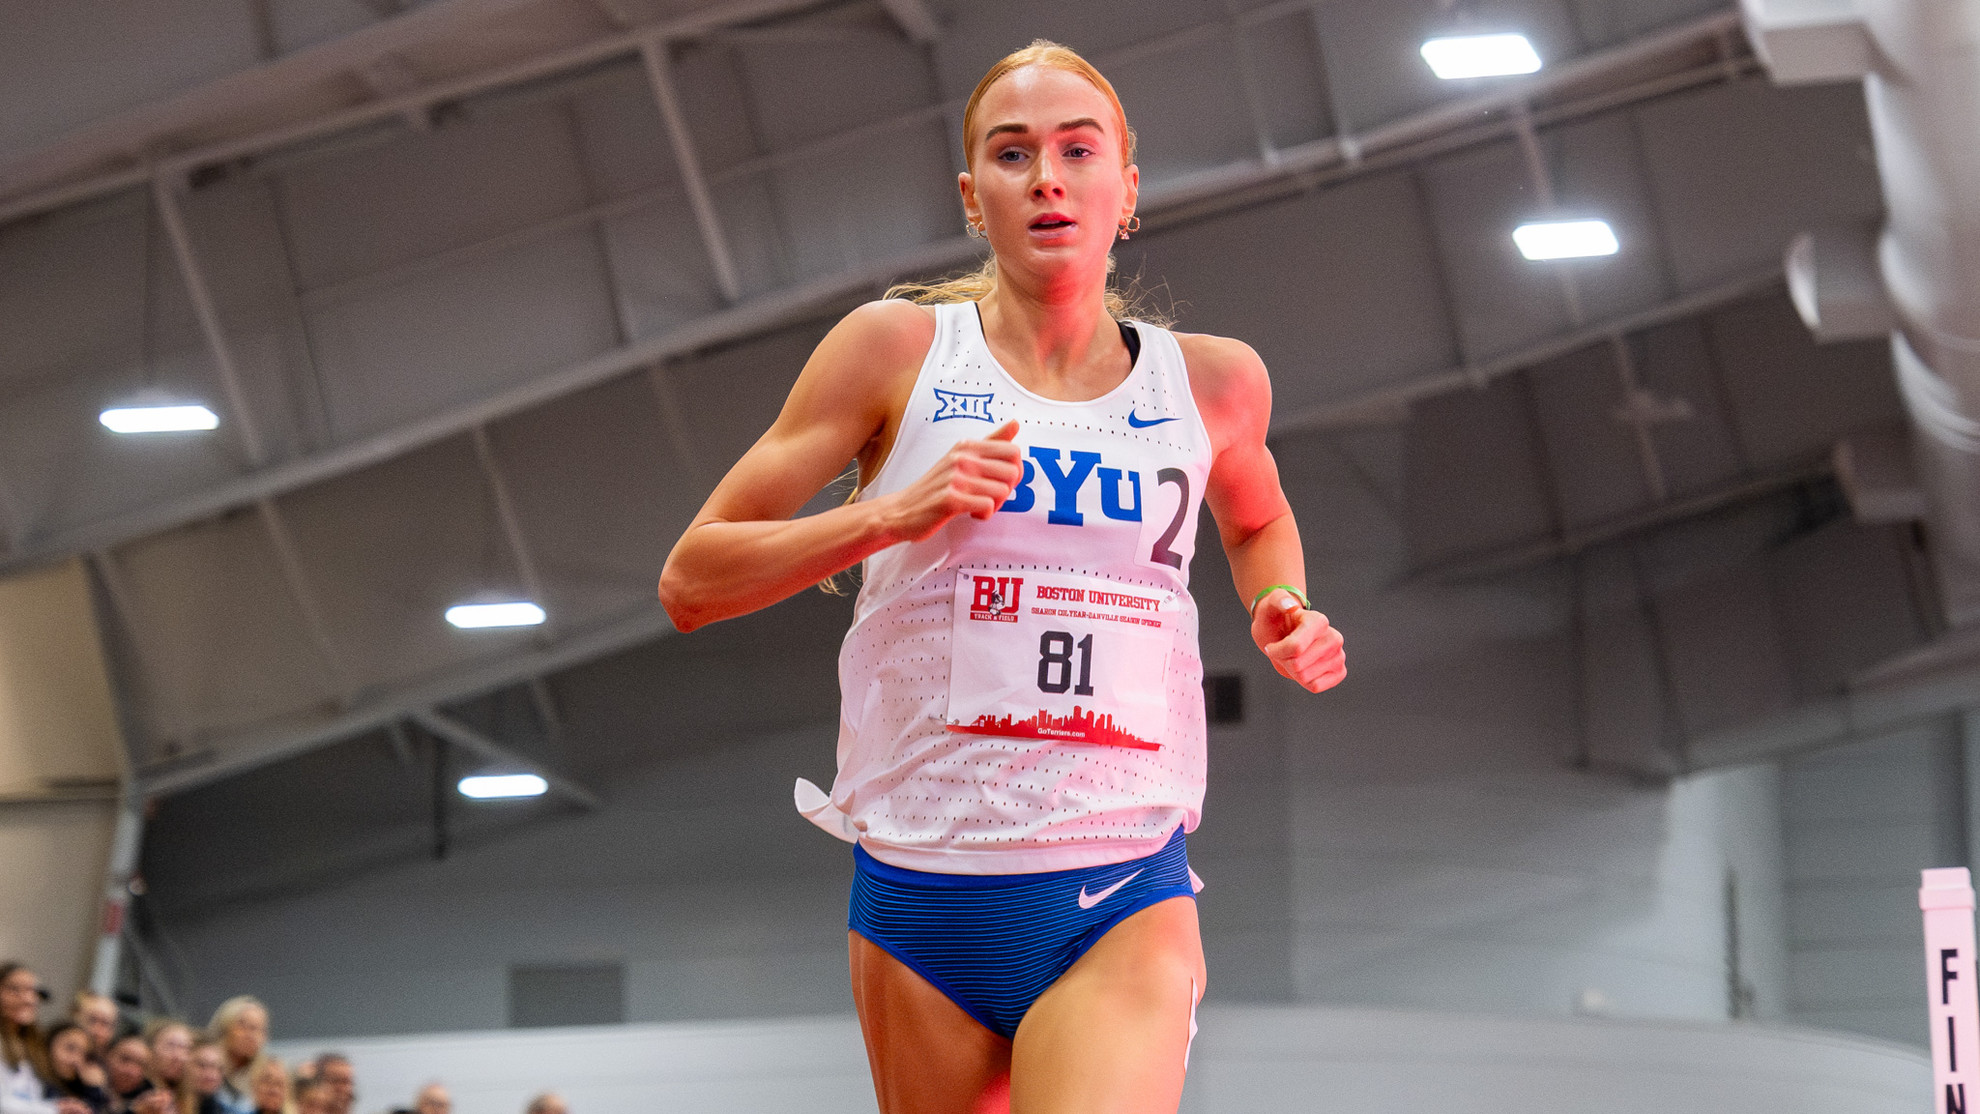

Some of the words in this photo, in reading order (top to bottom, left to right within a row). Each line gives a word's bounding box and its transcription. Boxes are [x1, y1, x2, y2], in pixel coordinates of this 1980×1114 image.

[1150, 468, 1190, 571] 2
[970, 576, 1024, 614] BU
[1036, 585, 1086, 603] BOSTON
[1088, 590, 1161, 612] UNIVERSITY
[974, 613, 993, 621] TRACK
[1031, 607, 1057, 616] SHARON
[1037, 630, 1094, 697] 81
[1037, 727, 1086, 738] GoTerriers.com
